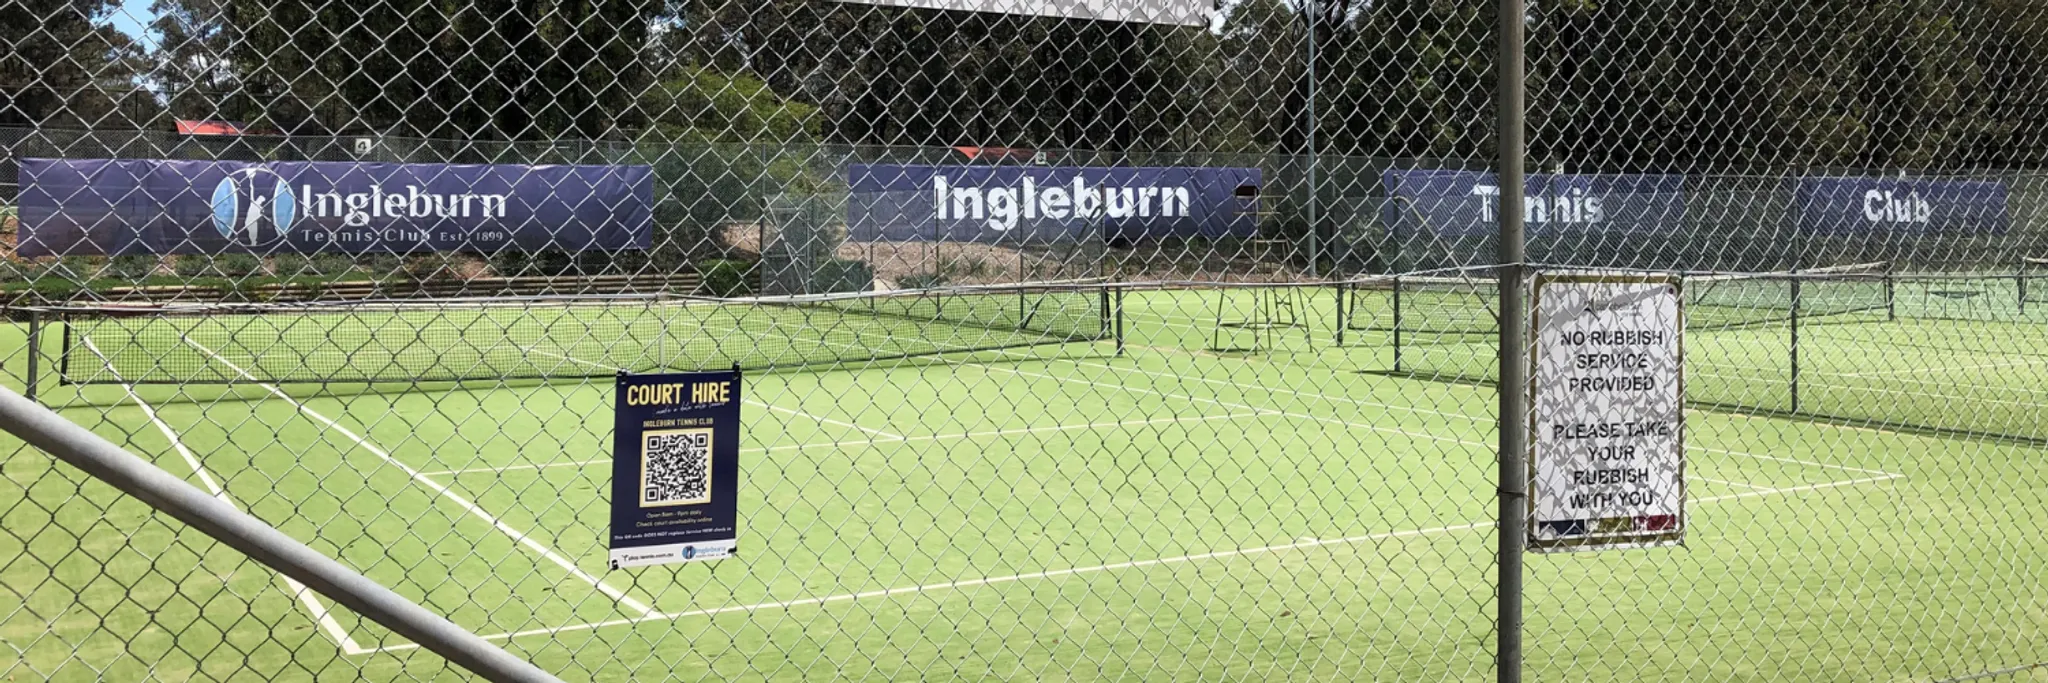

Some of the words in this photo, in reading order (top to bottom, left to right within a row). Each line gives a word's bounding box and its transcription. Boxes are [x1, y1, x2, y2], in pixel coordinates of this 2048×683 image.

[302, 184, 506, 226] Ingleburn
[934, 175, 1189, 232] Ingleburn
[1472, 185, 1604, 224] Tnnis
[1863, 189, 1931, 223] Club
[301, 229, 374, 243] Tennis
[383, 227, 432, 243] Club
[475, 230, 504, 243] 1899
[1560, 331, 1585, 346] NO
[1590, 330, 1663, 346] RUBBISH
[1576, 353, 1648, 369] SERVICE
[1569, 376, 1655, 392] PROVIDED
[627, 383, 684, 406] COURT
[692, 381, 730, 403] HIRE
[643, 419, 676, 428] INGLEBURN
[677, 418, 697, 426] TENNIS
[699, 417, 714, 425] CLUB
[1553, 423, 1621, 440] PLEASE
[1624, 421, 1668, 437] TAKE
[1587, 445, 1635, 461] YOUR
[1574, 469, 1649, 485] RUBBISH
[1569, 493, 1612, 509] WITH
[1618, 491, 1653, 507] YOU
